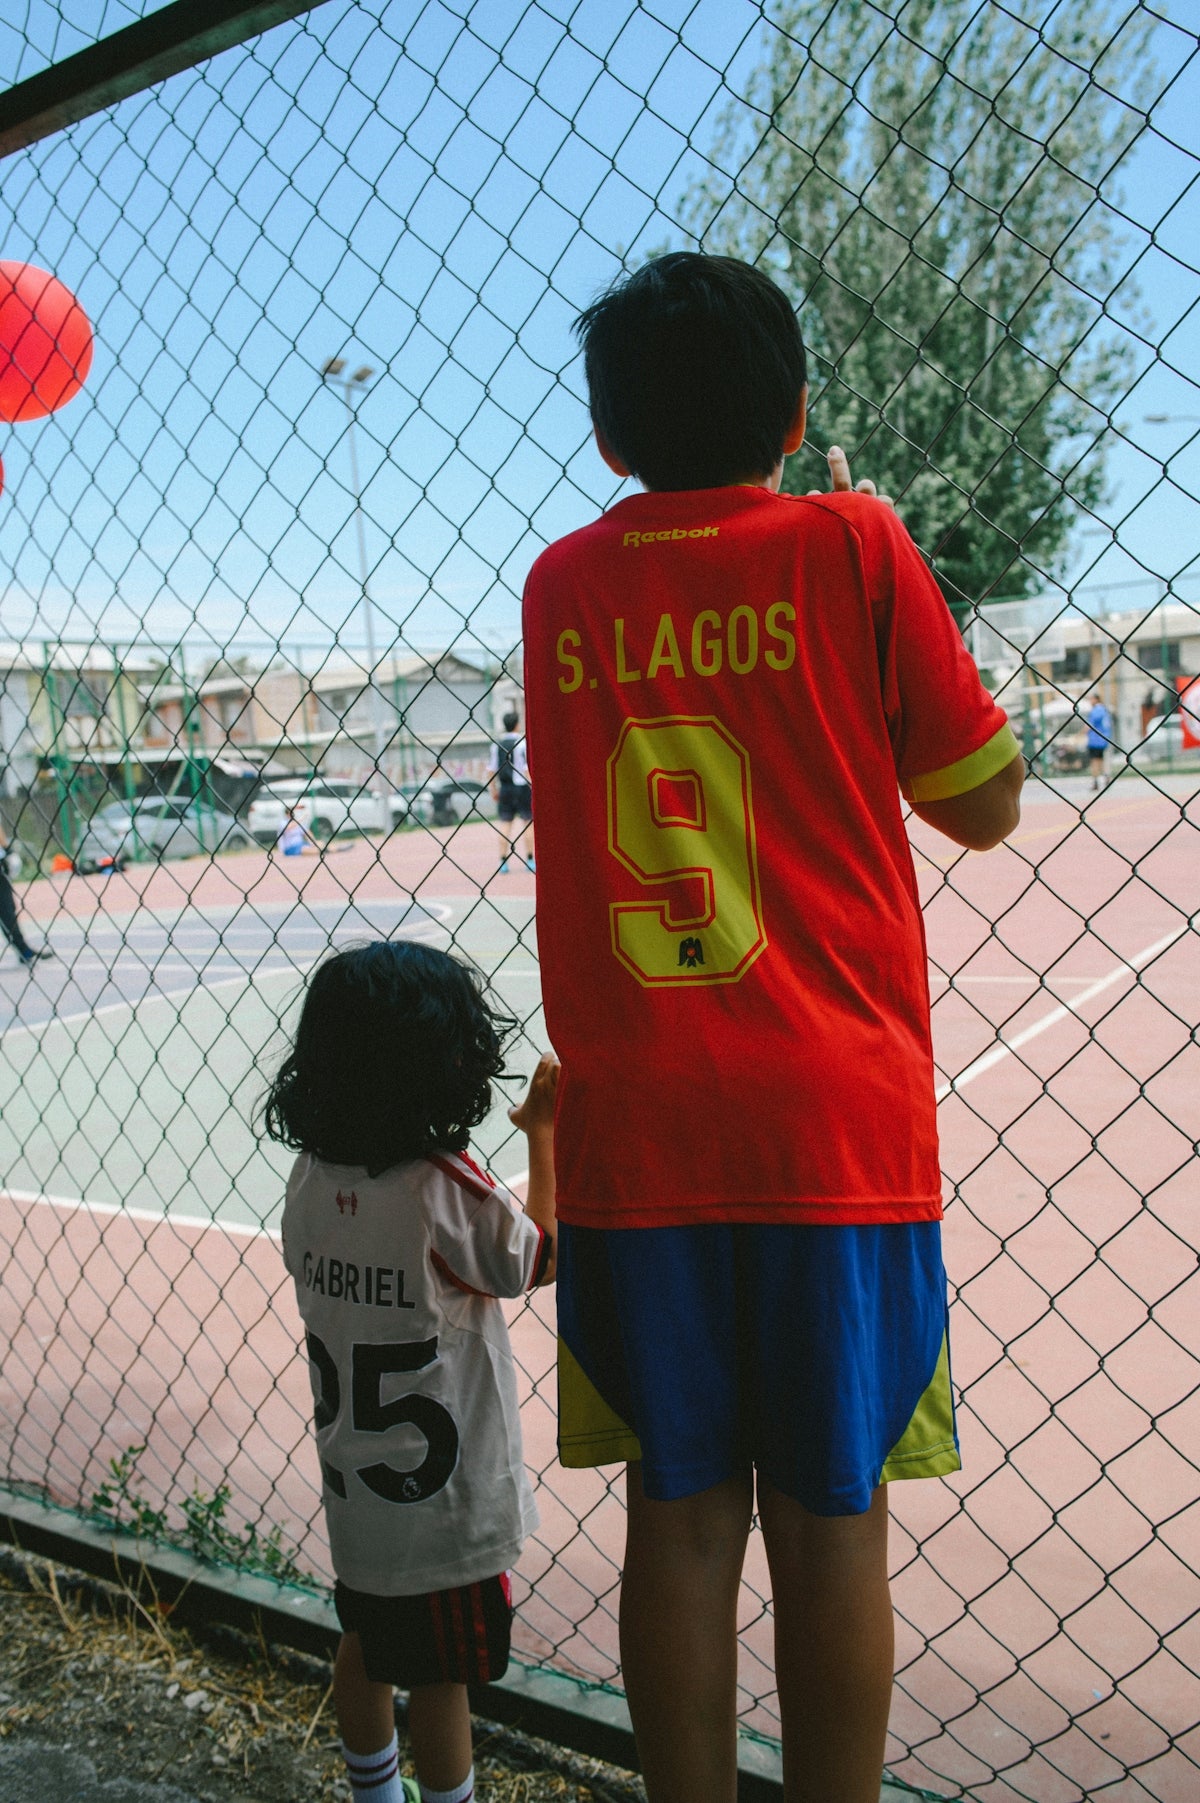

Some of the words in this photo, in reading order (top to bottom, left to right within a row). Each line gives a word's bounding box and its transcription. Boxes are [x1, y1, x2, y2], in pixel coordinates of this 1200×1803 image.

[623, 526, 720, 548] Reebok
[556, 629, 598, 693] S.
[614, 601, 797, 684] LAGOS
[606, 715, 769, 988] 9
[303, 1251, 416, 1309] GABRIEL
